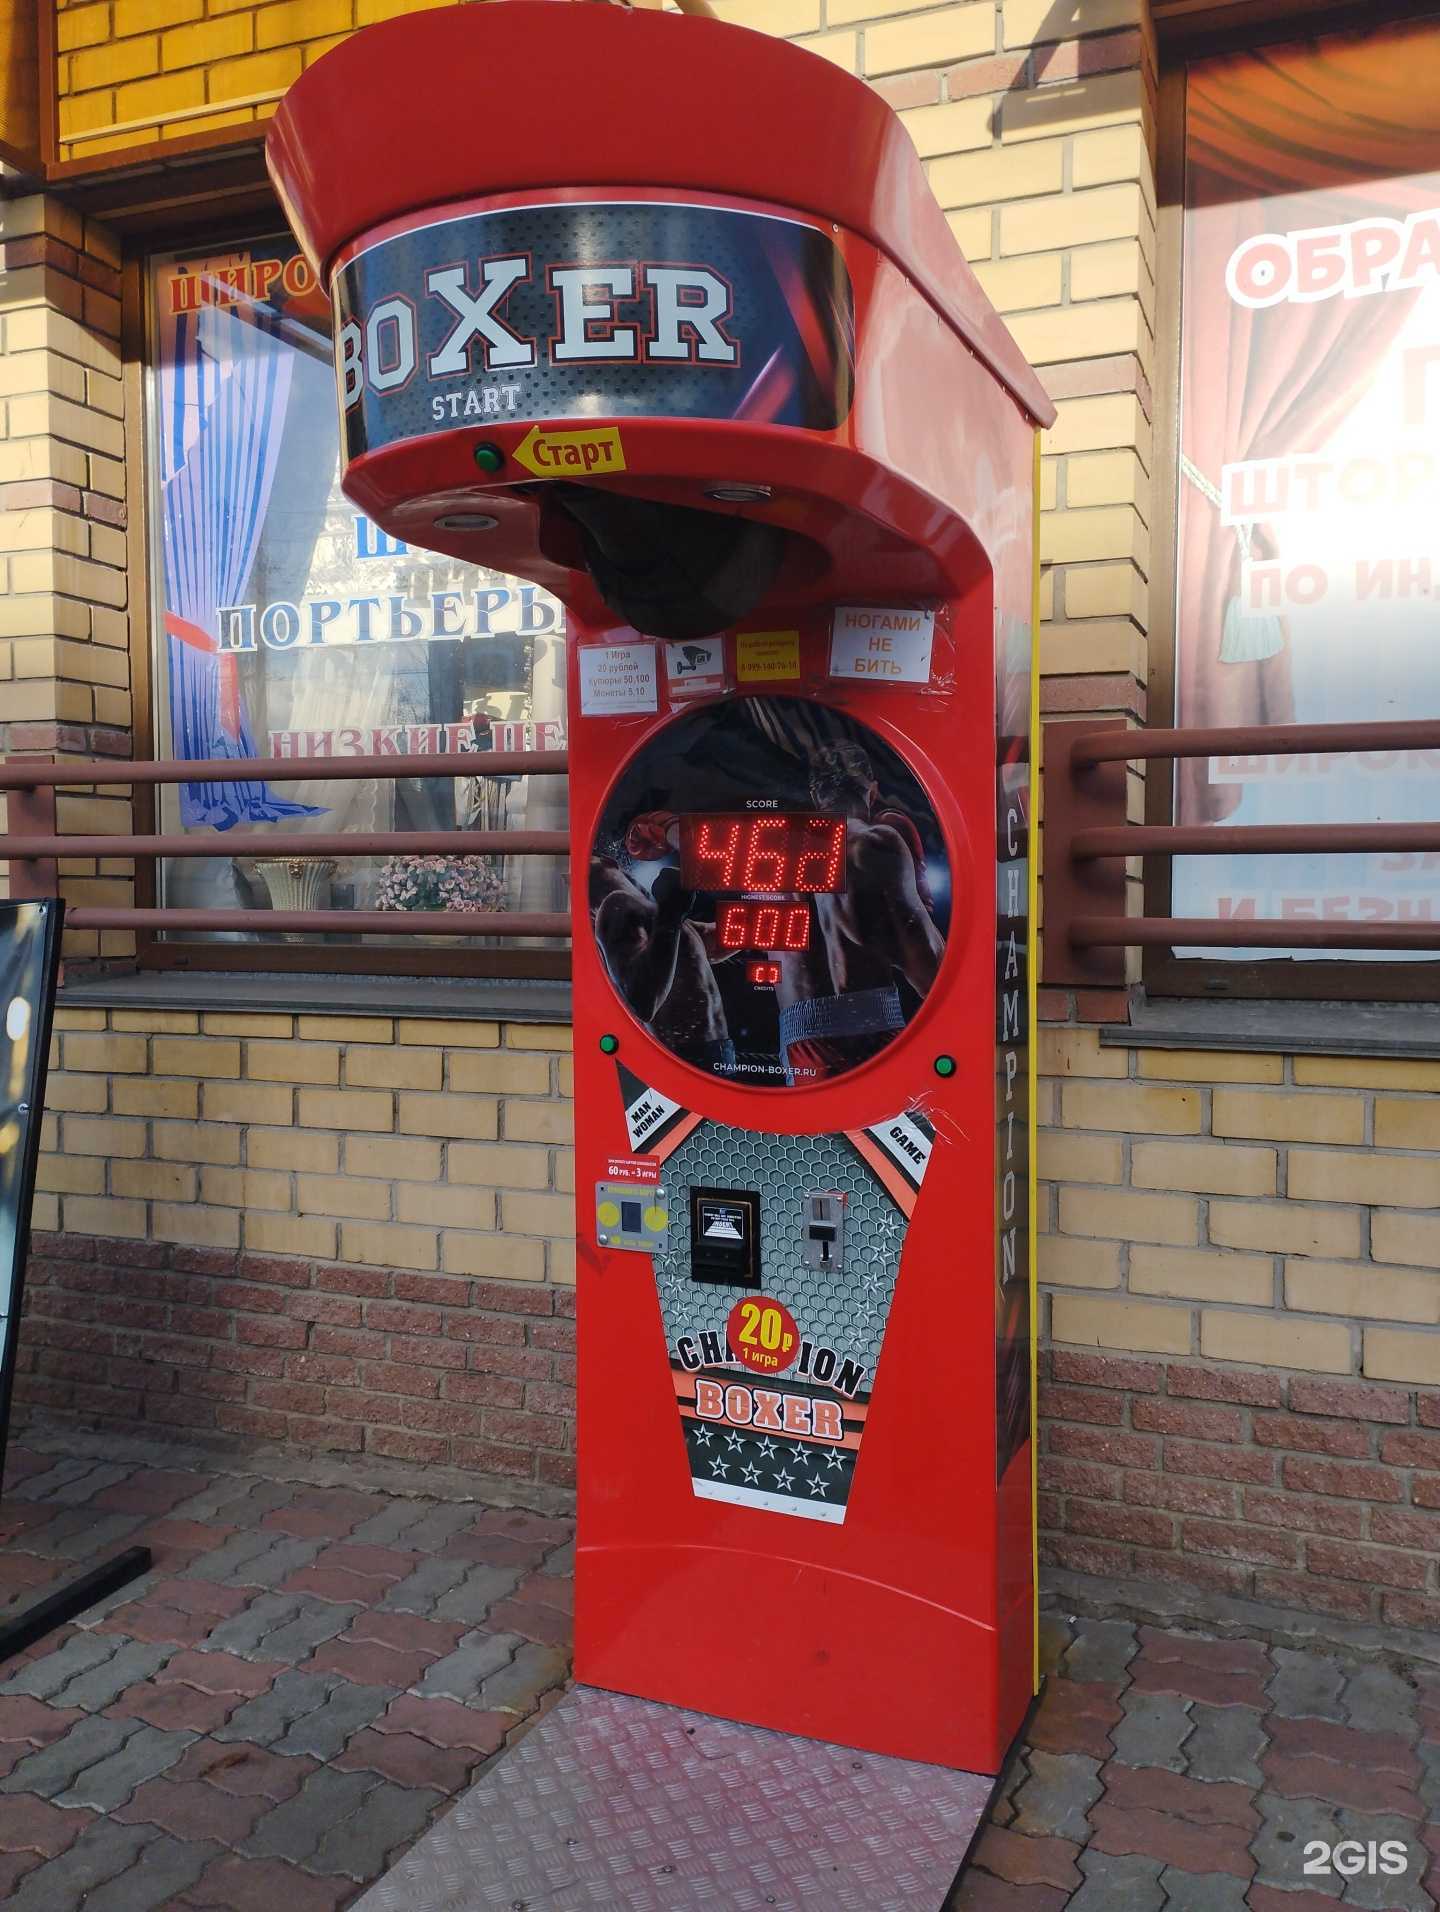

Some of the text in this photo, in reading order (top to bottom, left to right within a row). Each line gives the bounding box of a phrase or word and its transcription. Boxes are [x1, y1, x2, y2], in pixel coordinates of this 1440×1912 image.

[340, 255, 741, 412] BOXER
[432, 384, 521, 421] START
[532, 434, 614, 471] Старт
[1249, 558, 1440, 608] ПО ИН
[845, 613, 921, 631] НОГАМИ
[869, 636, 894, 652] НЕ
[854, 658, 903, 675] БИТЬ
[746, 800, 779, 809] SCORE
[723, 907, 810, 948] 600
[1003, 808, 1020, 1286] CHAMPION
[713, 1062, 817, 1077] CHAMPION-BOXER.RU
[631, 1100, 652, 1124] MAN
[632, 1104, 665, 1138] WOMAN
[889, 1126, 926, 1165] GAME
[608, 1165, 619, 1175] 60
[636, 1167, 641, 1177] 3
[676, 1329, 866, 1399] CHION
[743, 1347, 778, 1367] 1 игра
[695, 1379, 843, 1439] BOXER
